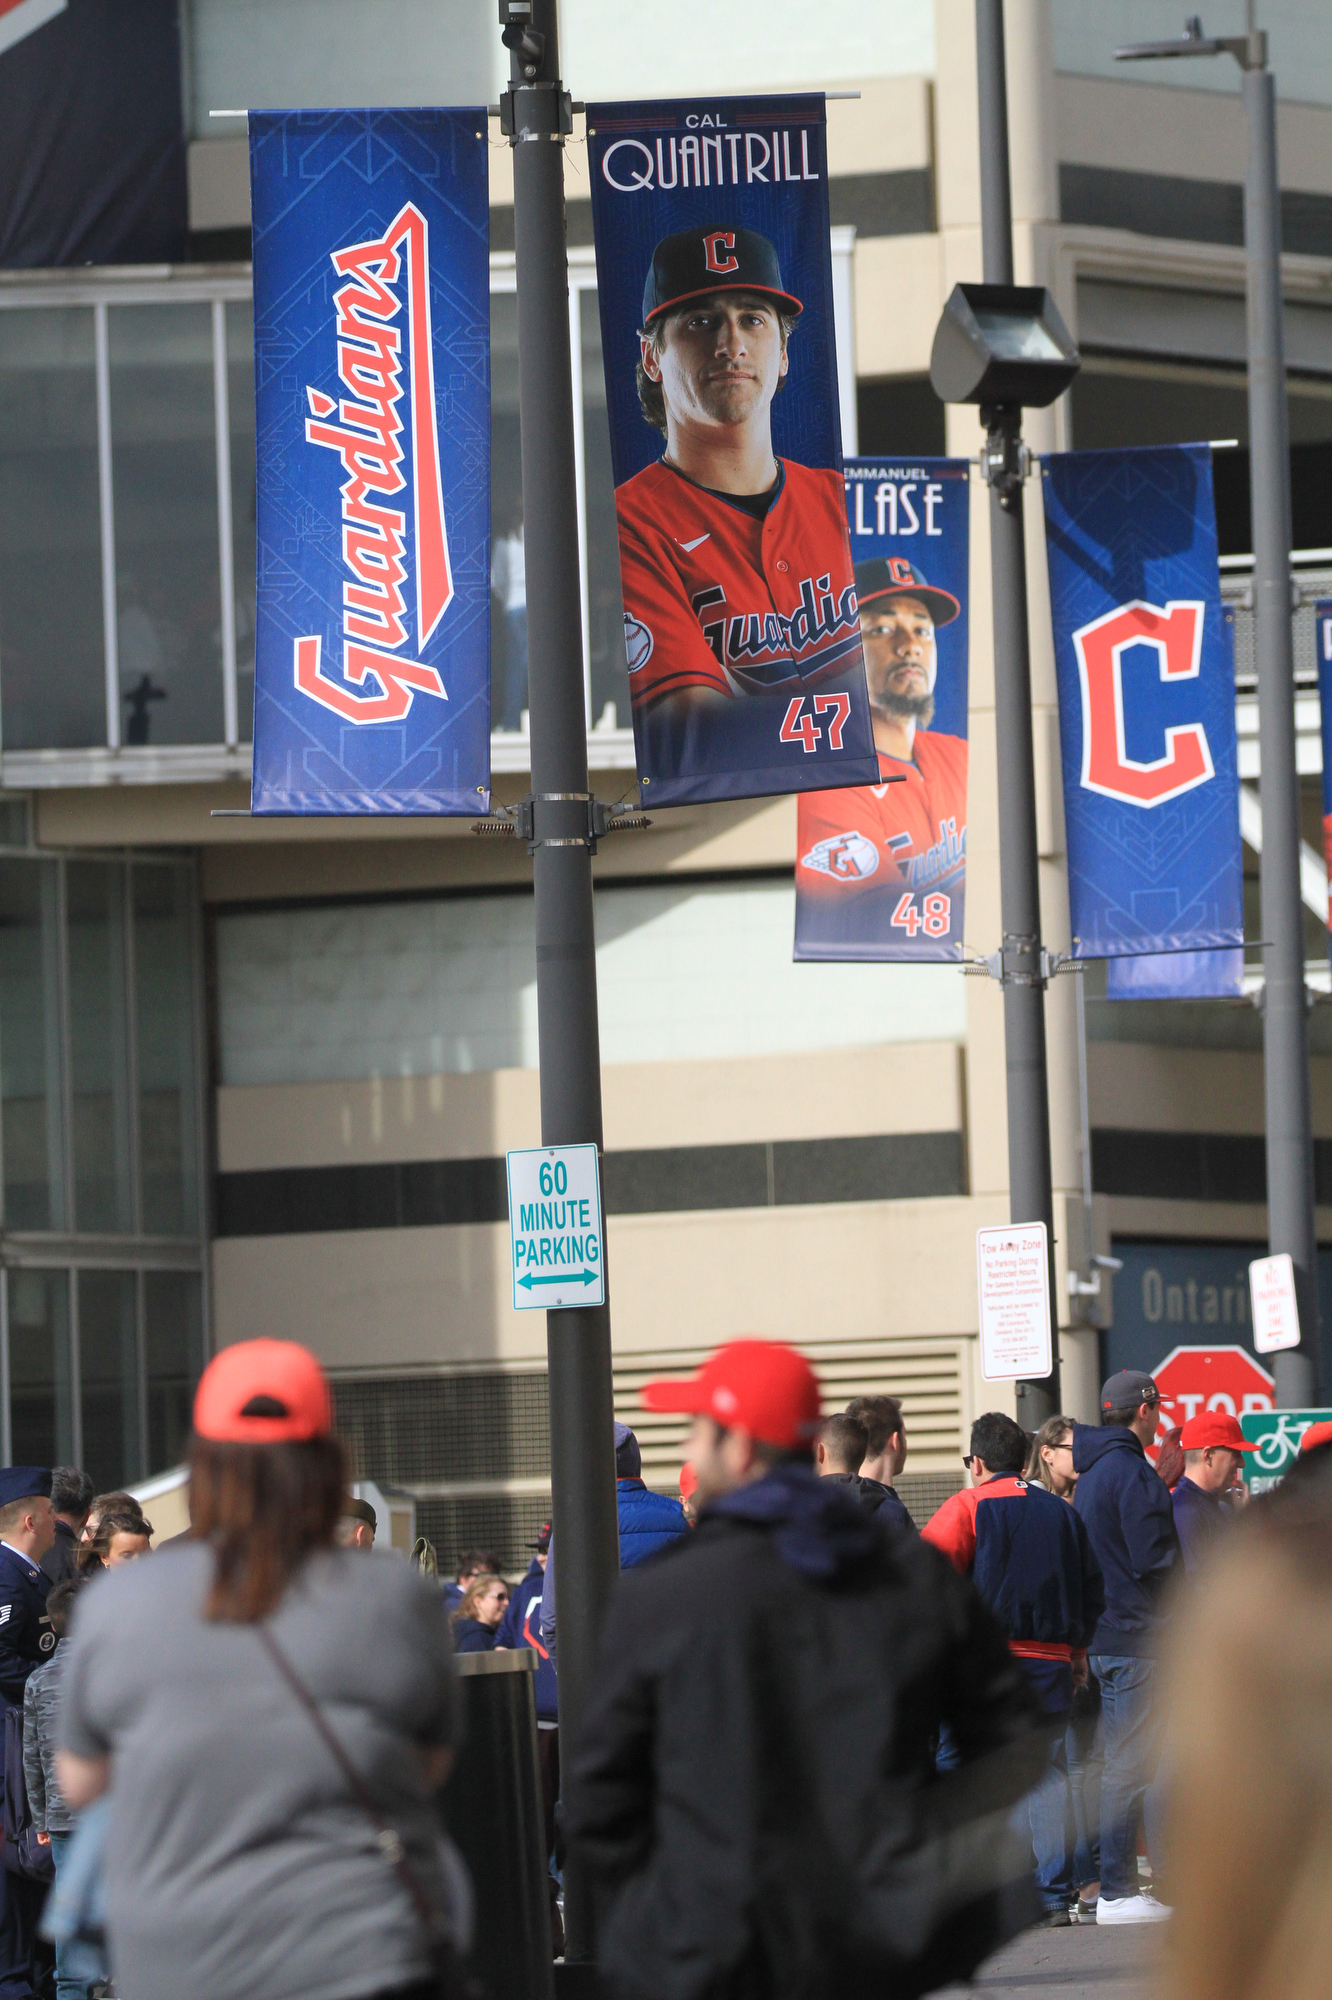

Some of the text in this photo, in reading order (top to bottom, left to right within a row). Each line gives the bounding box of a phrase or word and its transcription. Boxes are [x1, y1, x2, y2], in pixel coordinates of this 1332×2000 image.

[686, 114, 728, 128] CAL
[602, 130, 820, 192] QUANTRILL
[703, 232, 740, 274] C
[294, 200, 453, 725] Guardians
[844, 468, 930, 480] EMMANUEL
[844, 482, 944, 536] LASE
[886, 557, 915, 586] C
[779, 692, 851, 753] 47
[1072, 599, 1216, 809] C
[890, 892, 951, 938] 48
[539, 1160, 568, 1196] 60
[519, 1199, 591, 1232] MINUTE
[515, 1234, 599, 1267] PARKING
[981, 1243, 997, 1254] Tow
[1022, 1239, 1042, 1250] Zone
